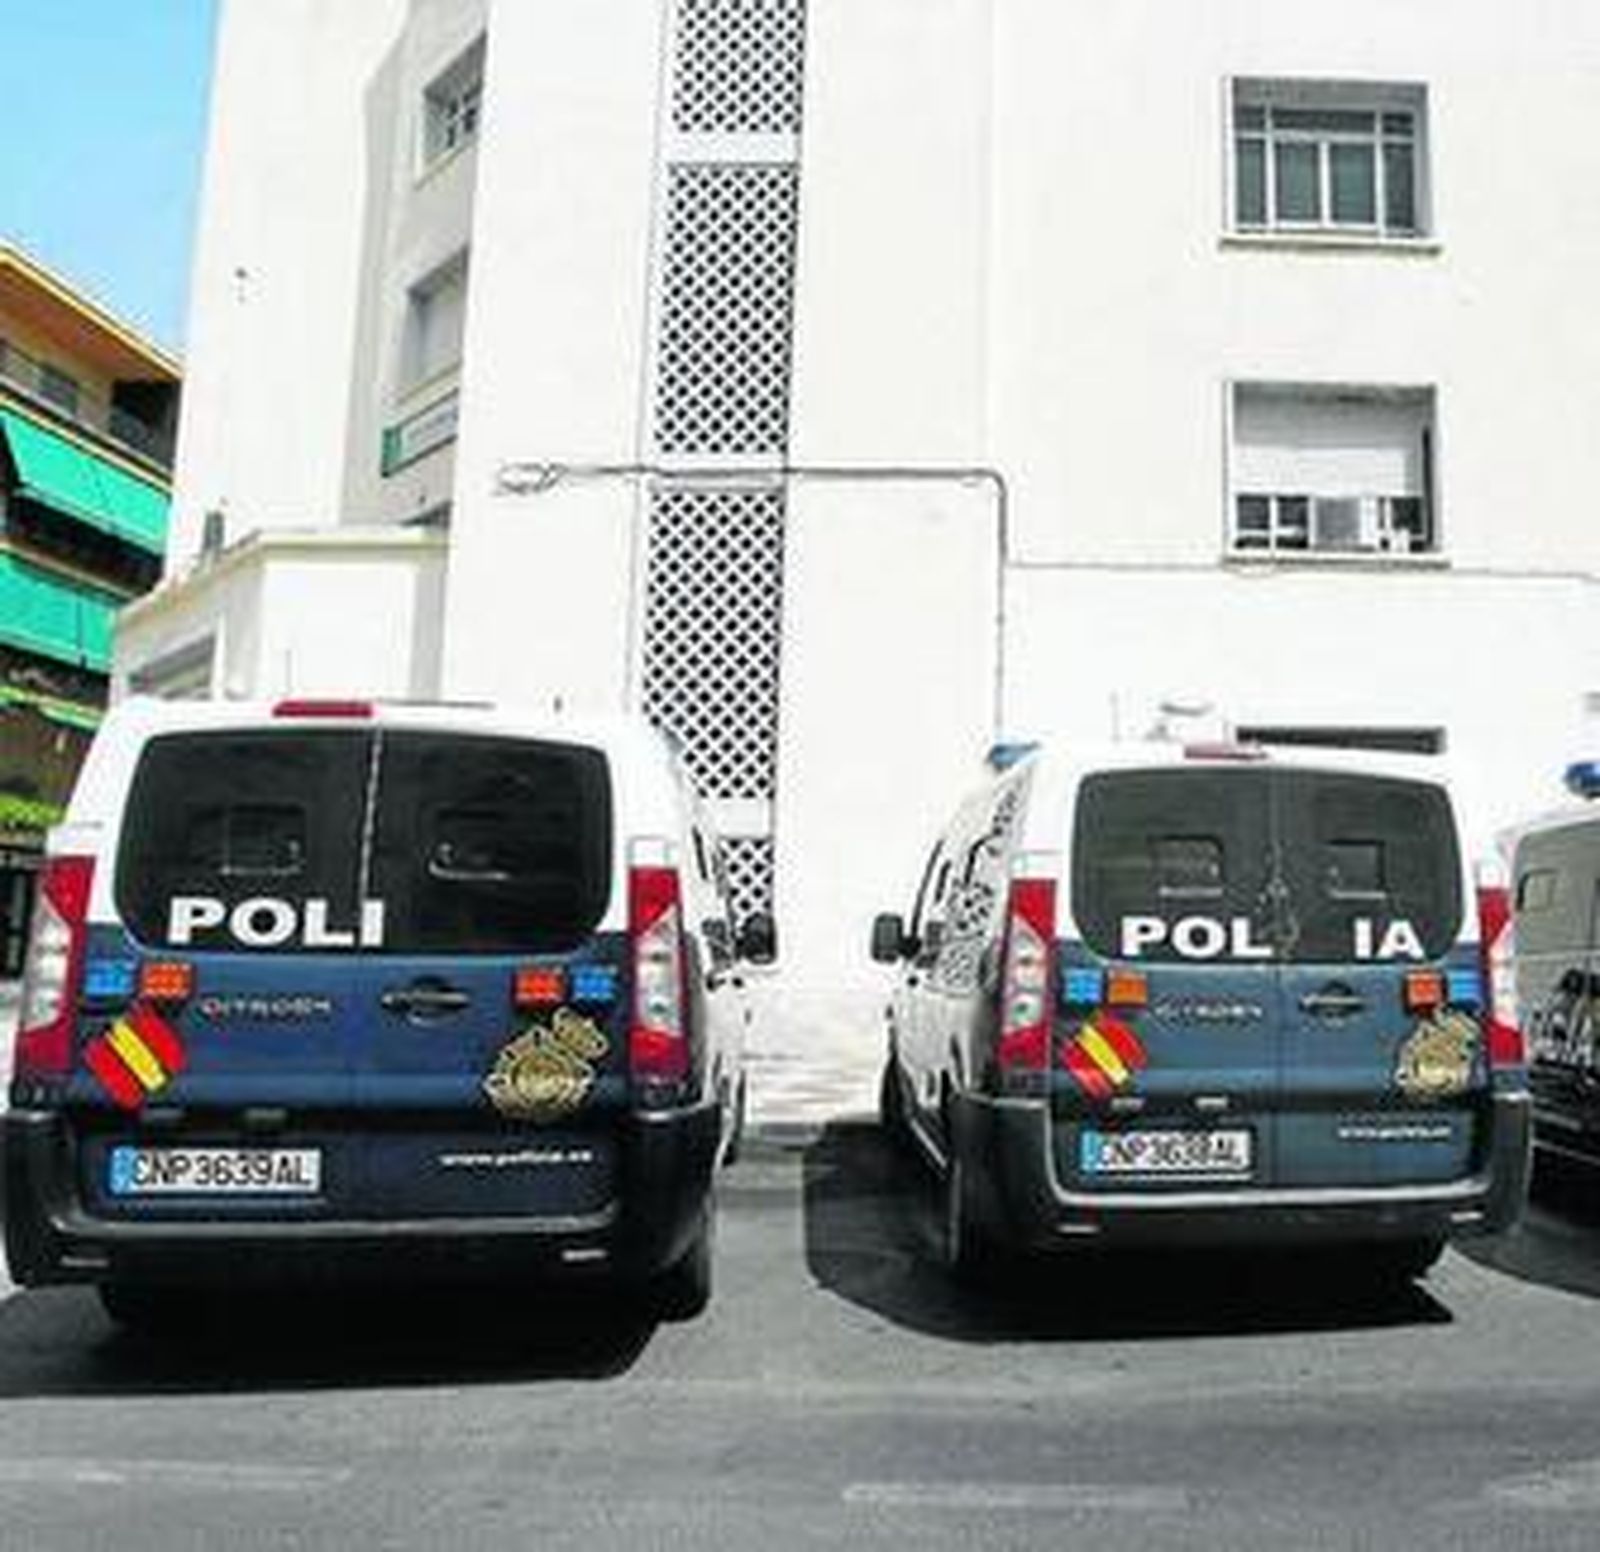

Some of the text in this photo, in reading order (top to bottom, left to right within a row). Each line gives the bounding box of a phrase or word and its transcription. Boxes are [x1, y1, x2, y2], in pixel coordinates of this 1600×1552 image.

[168, 896, 385, 947] POLI
[1120, 915, 1425, 960] POL IA
